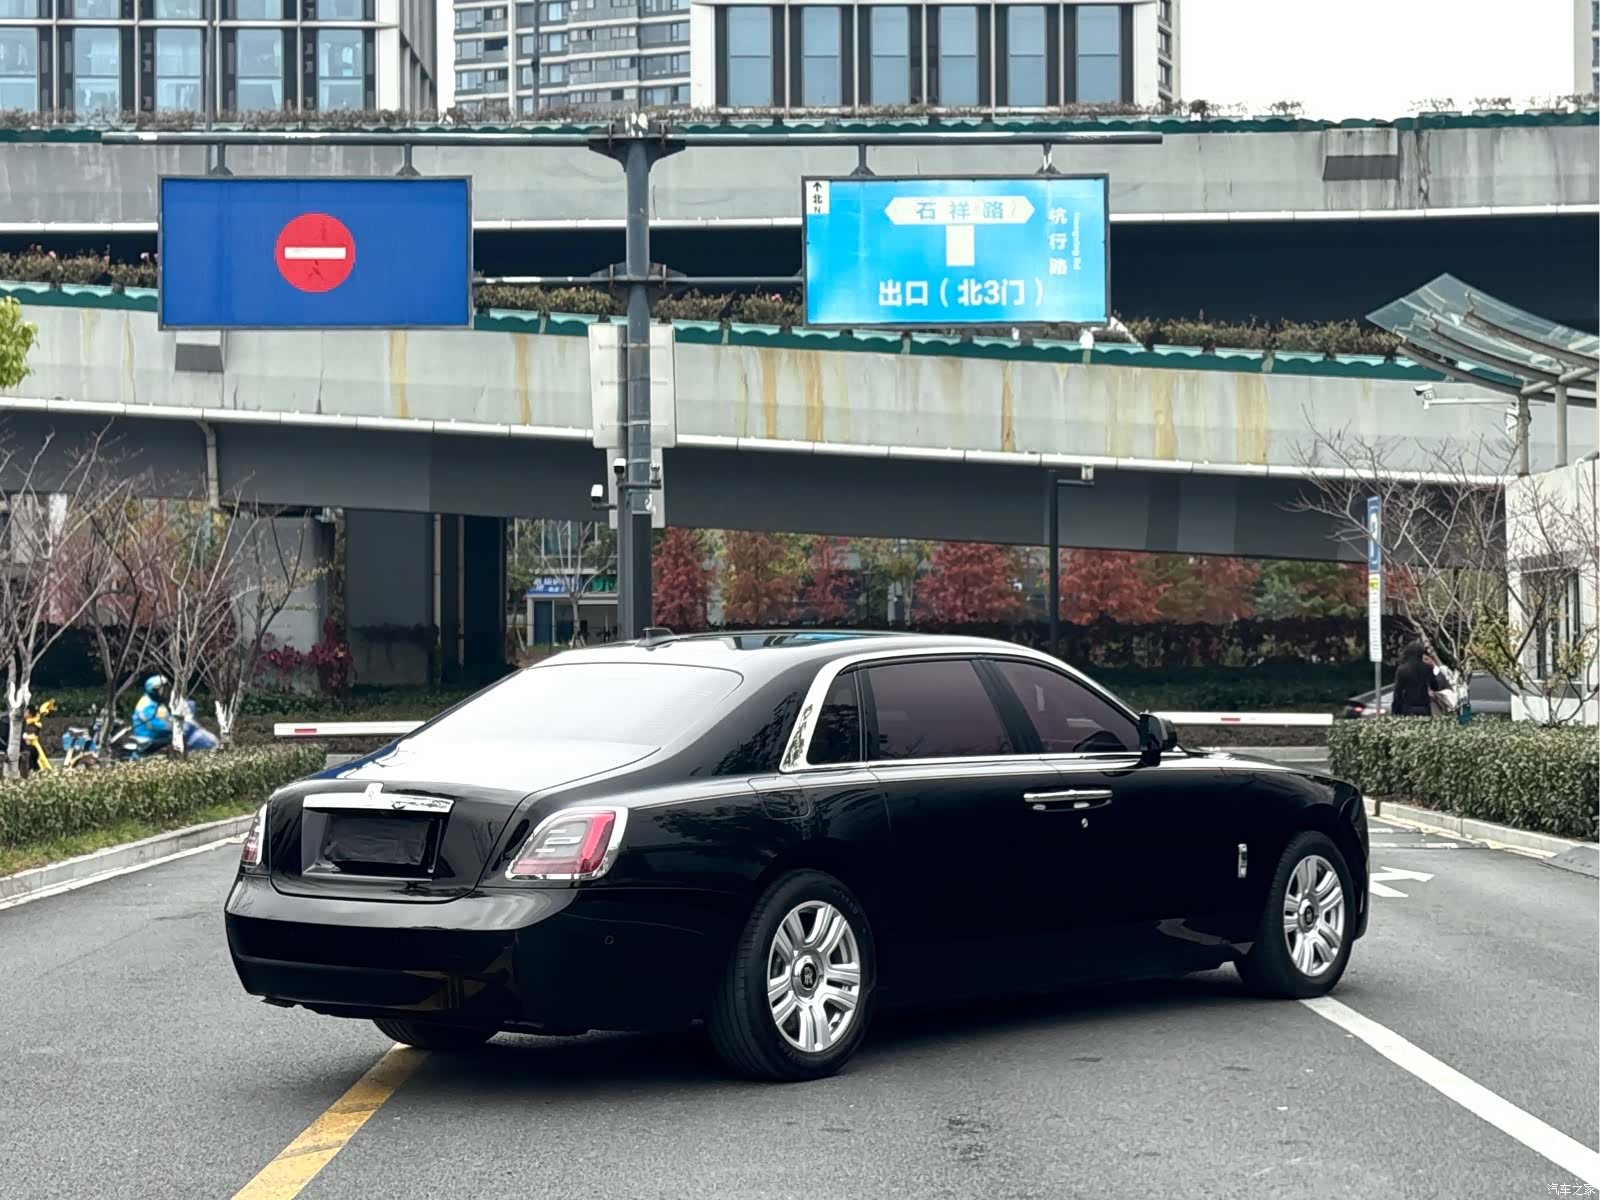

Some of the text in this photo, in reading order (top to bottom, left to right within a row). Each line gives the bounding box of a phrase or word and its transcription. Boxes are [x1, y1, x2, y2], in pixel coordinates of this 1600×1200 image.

[812, 194, 822, 204] 北
[916, 201, 1003, 220] 石祥路
[1048, 208, 1067, 275] 杭行路
